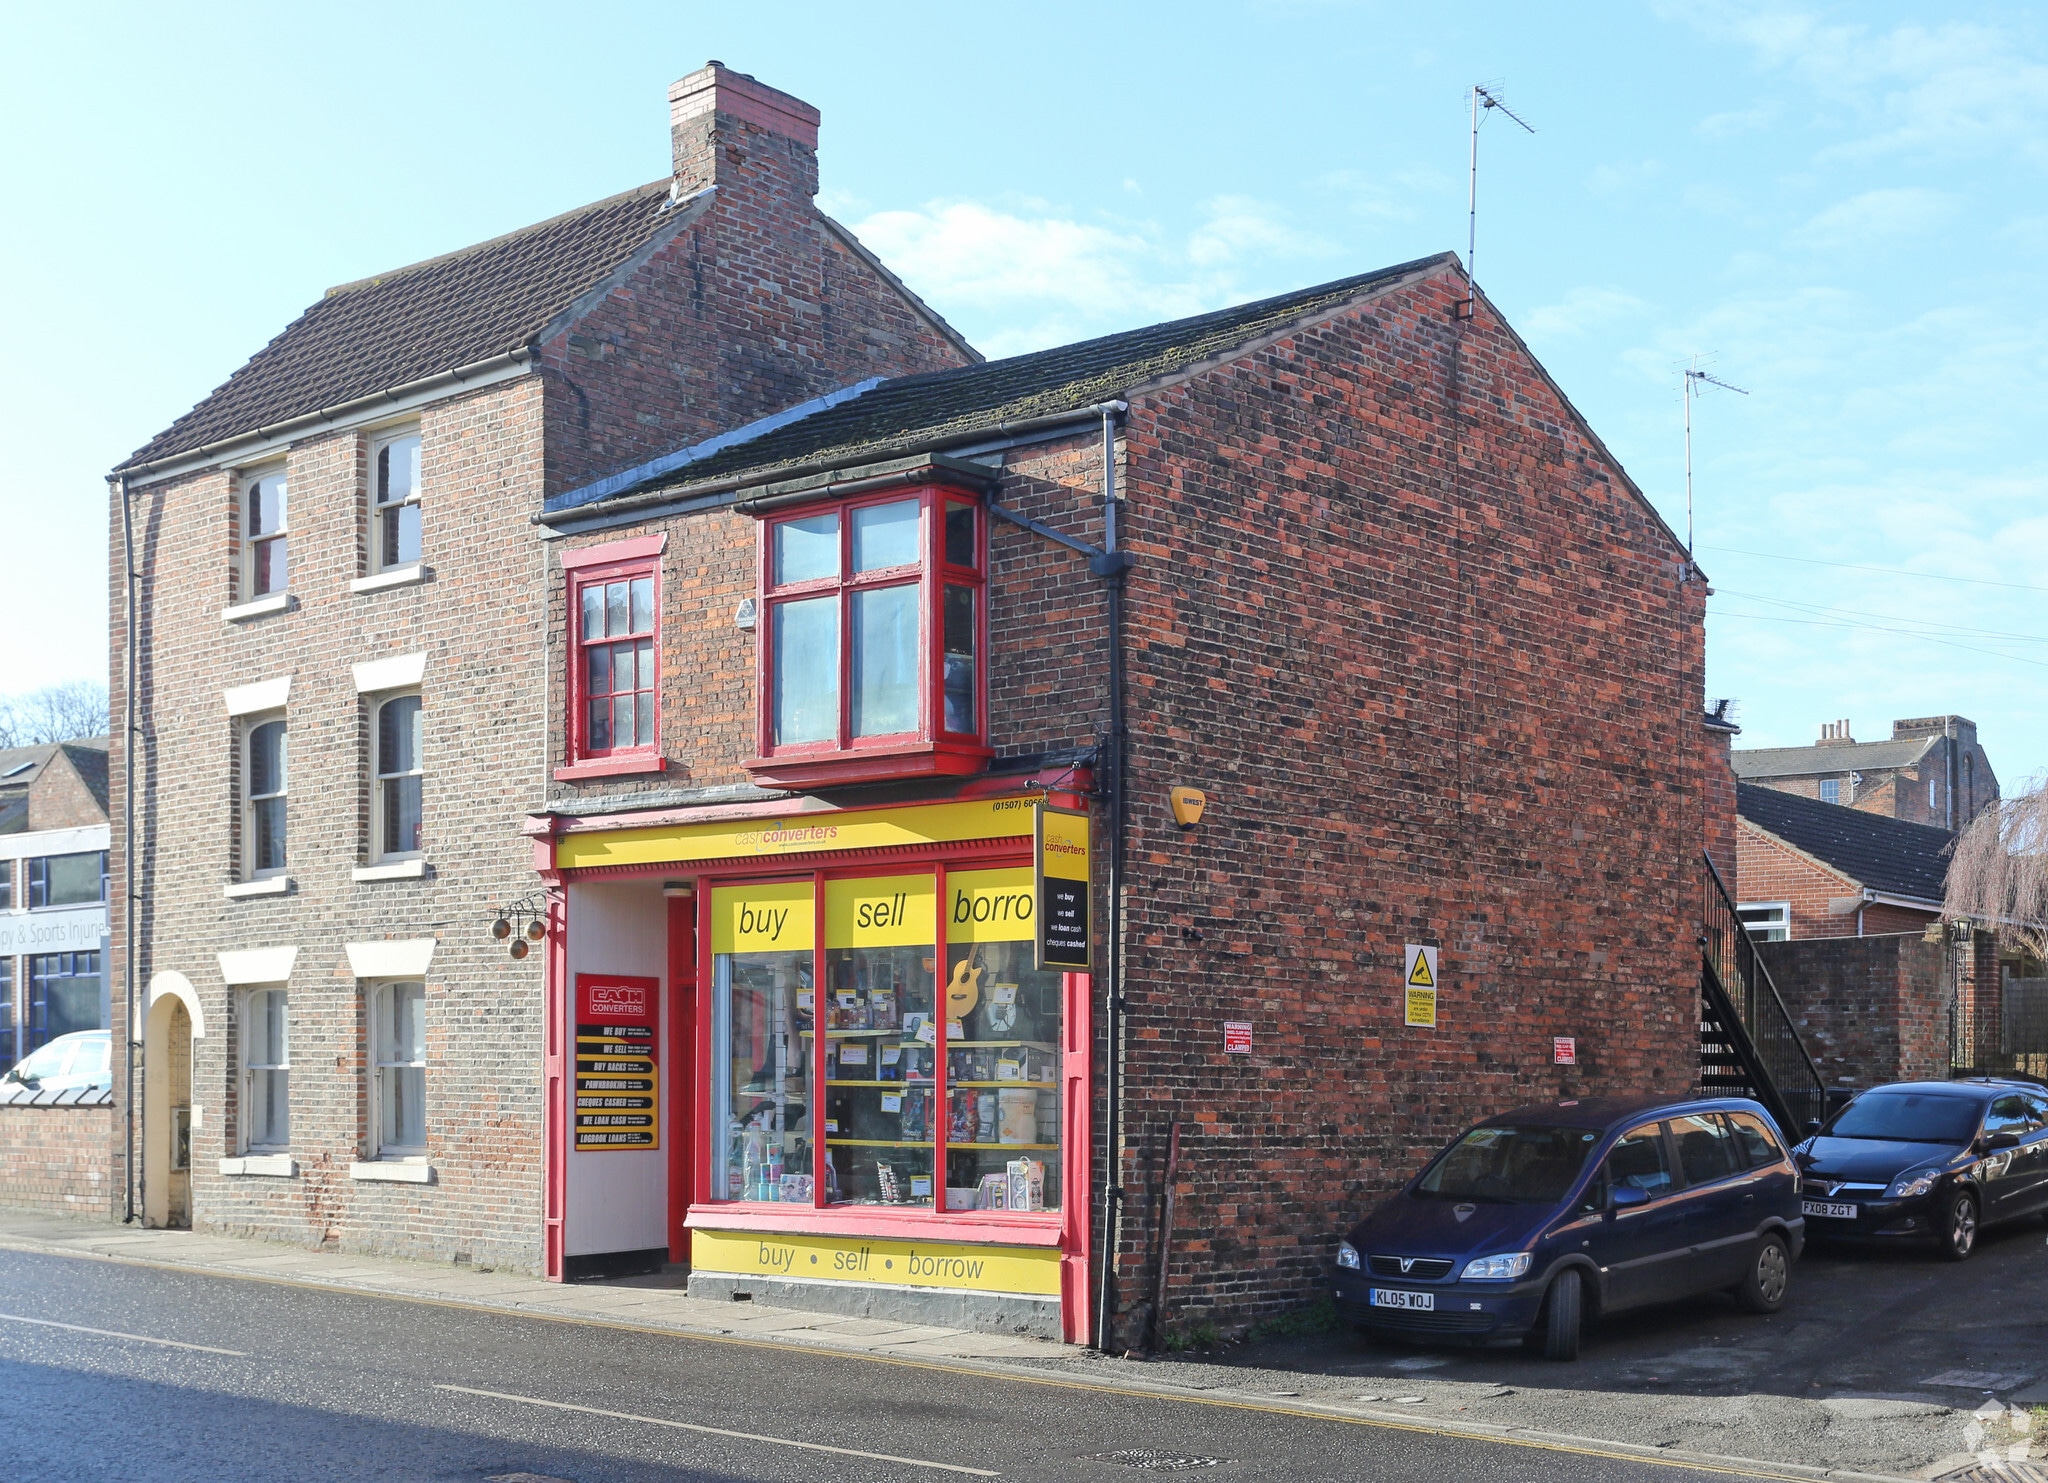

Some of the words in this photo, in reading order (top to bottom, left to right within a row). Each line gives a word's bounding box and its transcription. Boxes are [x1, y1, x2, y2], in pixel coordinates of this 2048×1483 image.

[992, 800, 1021, 812] (01507)
[1046, 834, 1063, 844] cash
[1045, 842, 1086, 856] converters
[1064, 892, 1075, 903] buy
[857, 893, 906, 928] sell
[953, 889, 1034, 924] borro
[738, 902, 788, 942] buy
[1058, 923, 1070, 932] loan
[17, 923, 26, 945] &
[30, 922, 65, 948] Sports
[1046, 938, 1066, 948] cheques
[1066, 940, 1086, 948] cashed
[1408, 990, 1434, 1000] WARNING
[592, 1003, 644, 1014] CONVERTERS
[603, 1026, 614, 1036] WE
[614, 1027, 627, 1036] BUY
[603, 1044, 614, 1053] WE
[614, 1045, 627, 1054] SELL
[1227, 1043, 1250, 1052] CLAMPED
[593, 1062, 607, 1071] BUY
[607, 1062, 627, 1071] BACKS
[585, 1080, 627, 1089] PAWNBROKING
[577, 1097, 603, 1107] CHEQUES
[604, 1098, 627, 1106] CASHED
[583, 1116, 593, 1125] WE
[594, 1116, 610, 1125] LOAN
[610, 1116, 627, 1125] CASH
[580, 1134, 607, 1143] LOGBOOK
[608, 1134, 627, 1143] LOANS
[1803, 1202, 1828, 1214] FX08
[1830, 1204, 1852, 1216] ZGT
[758, 1240, 795, 1273] buy
[834, 1246, 870, 1272] sell
[908, 1249, 984, 1279] borrow
[1376, 1290, 1406, 1306] KL05
[1408, 1293, 1432, 1309] WOJ
